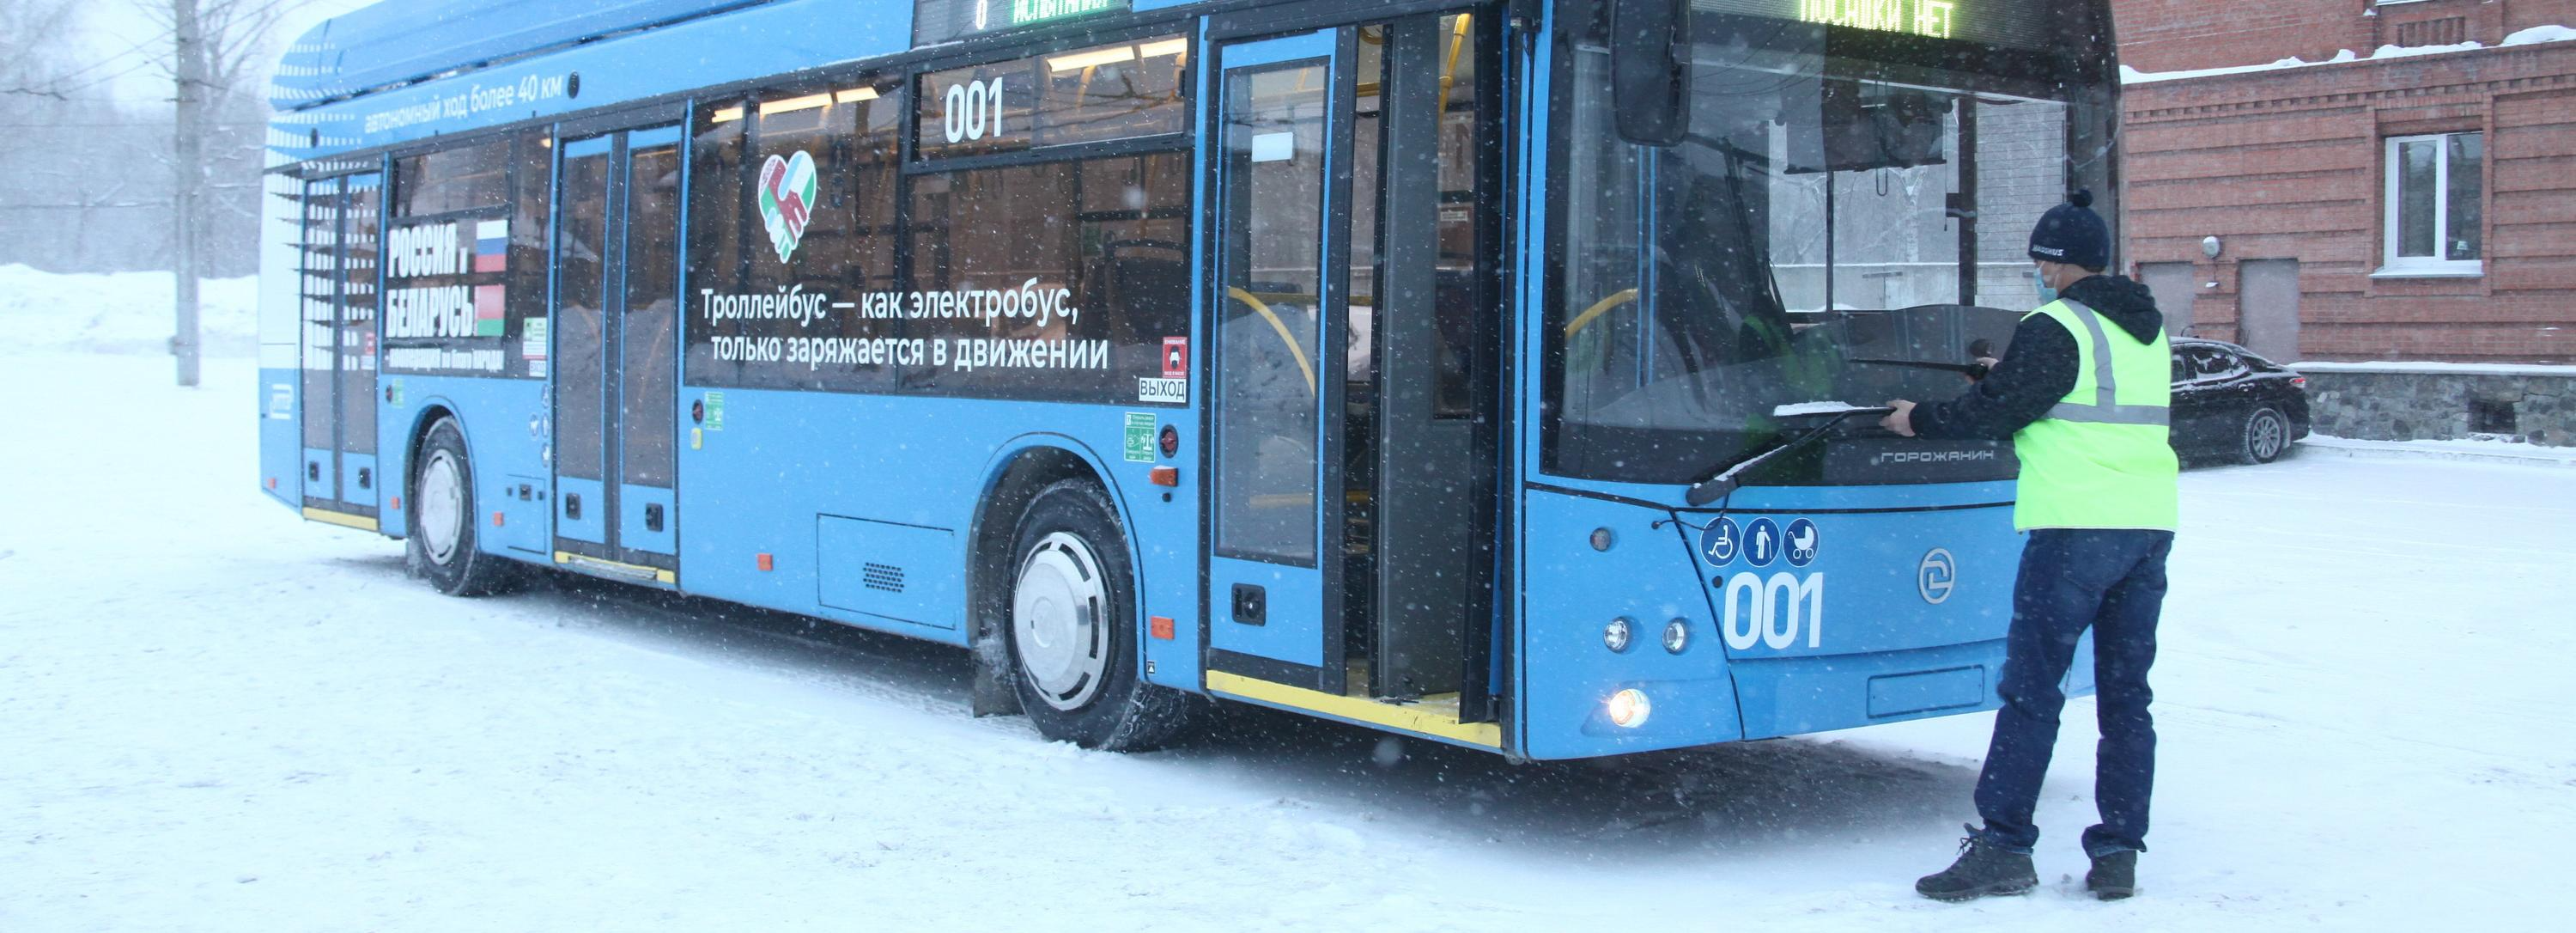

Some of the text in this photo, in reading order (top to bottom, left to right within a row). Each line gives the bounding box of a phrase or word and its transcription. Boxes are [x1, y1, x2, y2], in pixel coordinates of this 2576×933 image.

[1913, 0, 1953, 39] НЕТ
[364, 74, 562, 134] автономный ход более 40 км
[945, 76, 1003, 143] 001
[388, 223, 457, 277] РОССИЯ
[386, 284, 474, 338] БЕЛАРУСЬ
[701, 284, 826, 327] Троллейбус
[861, 291, 903, 319] как
[909, 277, 1078, 327] электробус,
[711, 336, 1108, 372] только заряжается в движении
[1140, 380, 1185, 400] ВЫХОД
[1880, 450, 1994, 462] ГОРОЖАНИН
[1723, 571, 1824, 650] 001
